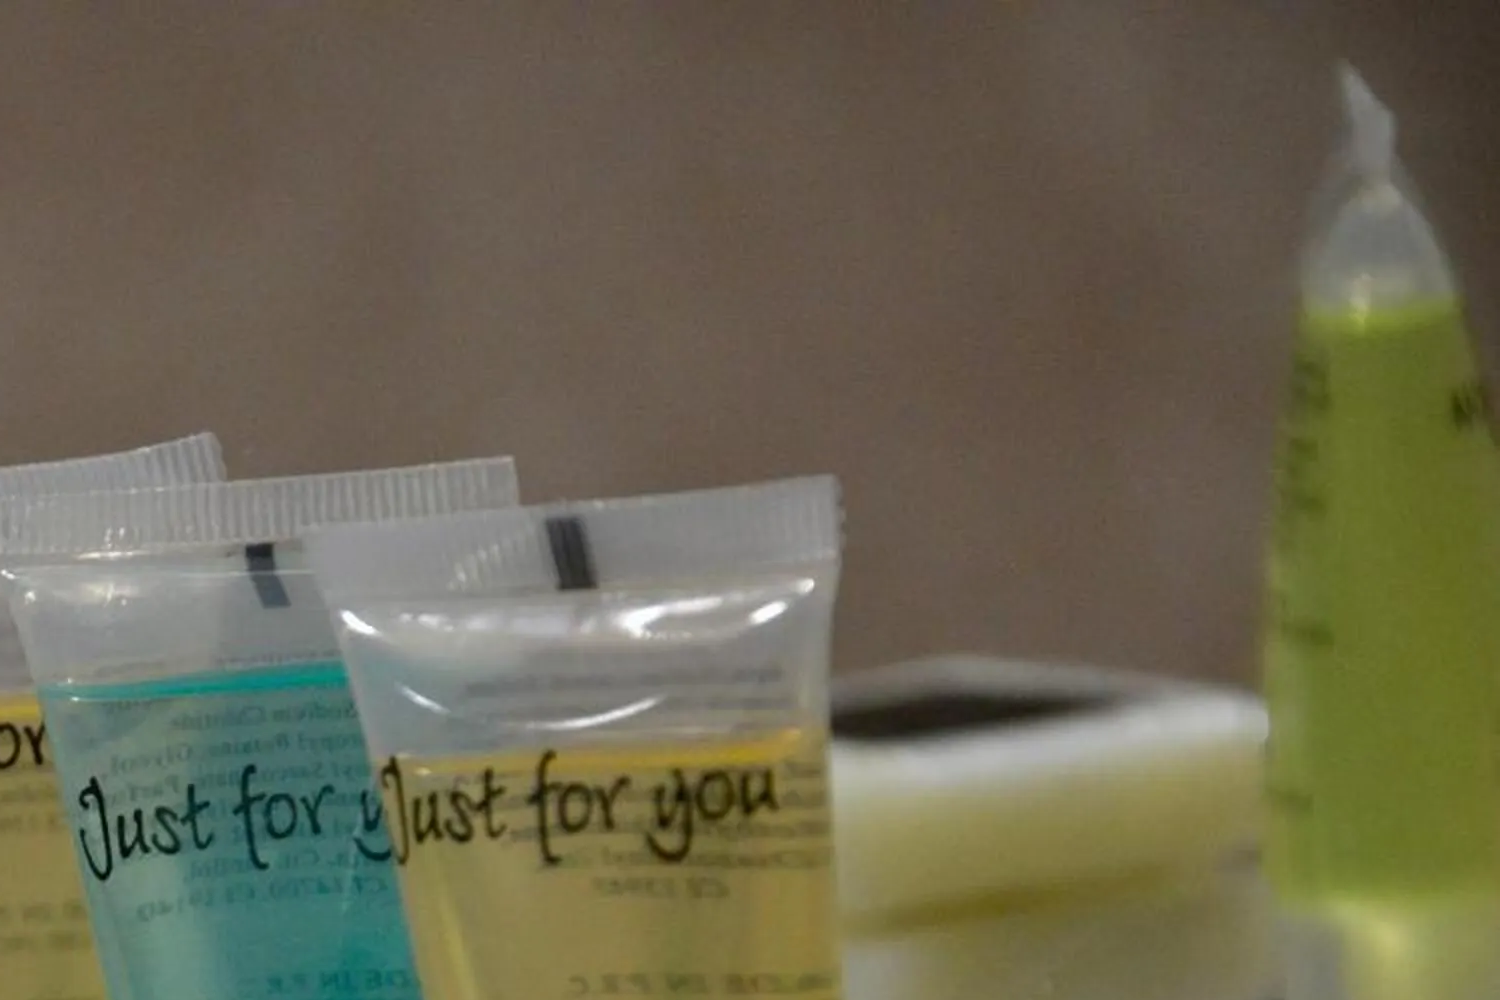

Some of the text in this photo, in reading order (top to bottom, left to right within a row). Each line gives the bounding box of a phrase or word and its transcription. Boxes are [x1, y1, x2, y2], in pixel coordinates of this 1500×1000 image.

[79, 776, 214, 880] Just
[233, 764, 335, 870] for
[380, 756, 506, 866] Just
[526, 750, 631, 866] for
[645, 766, 779, 863] you
